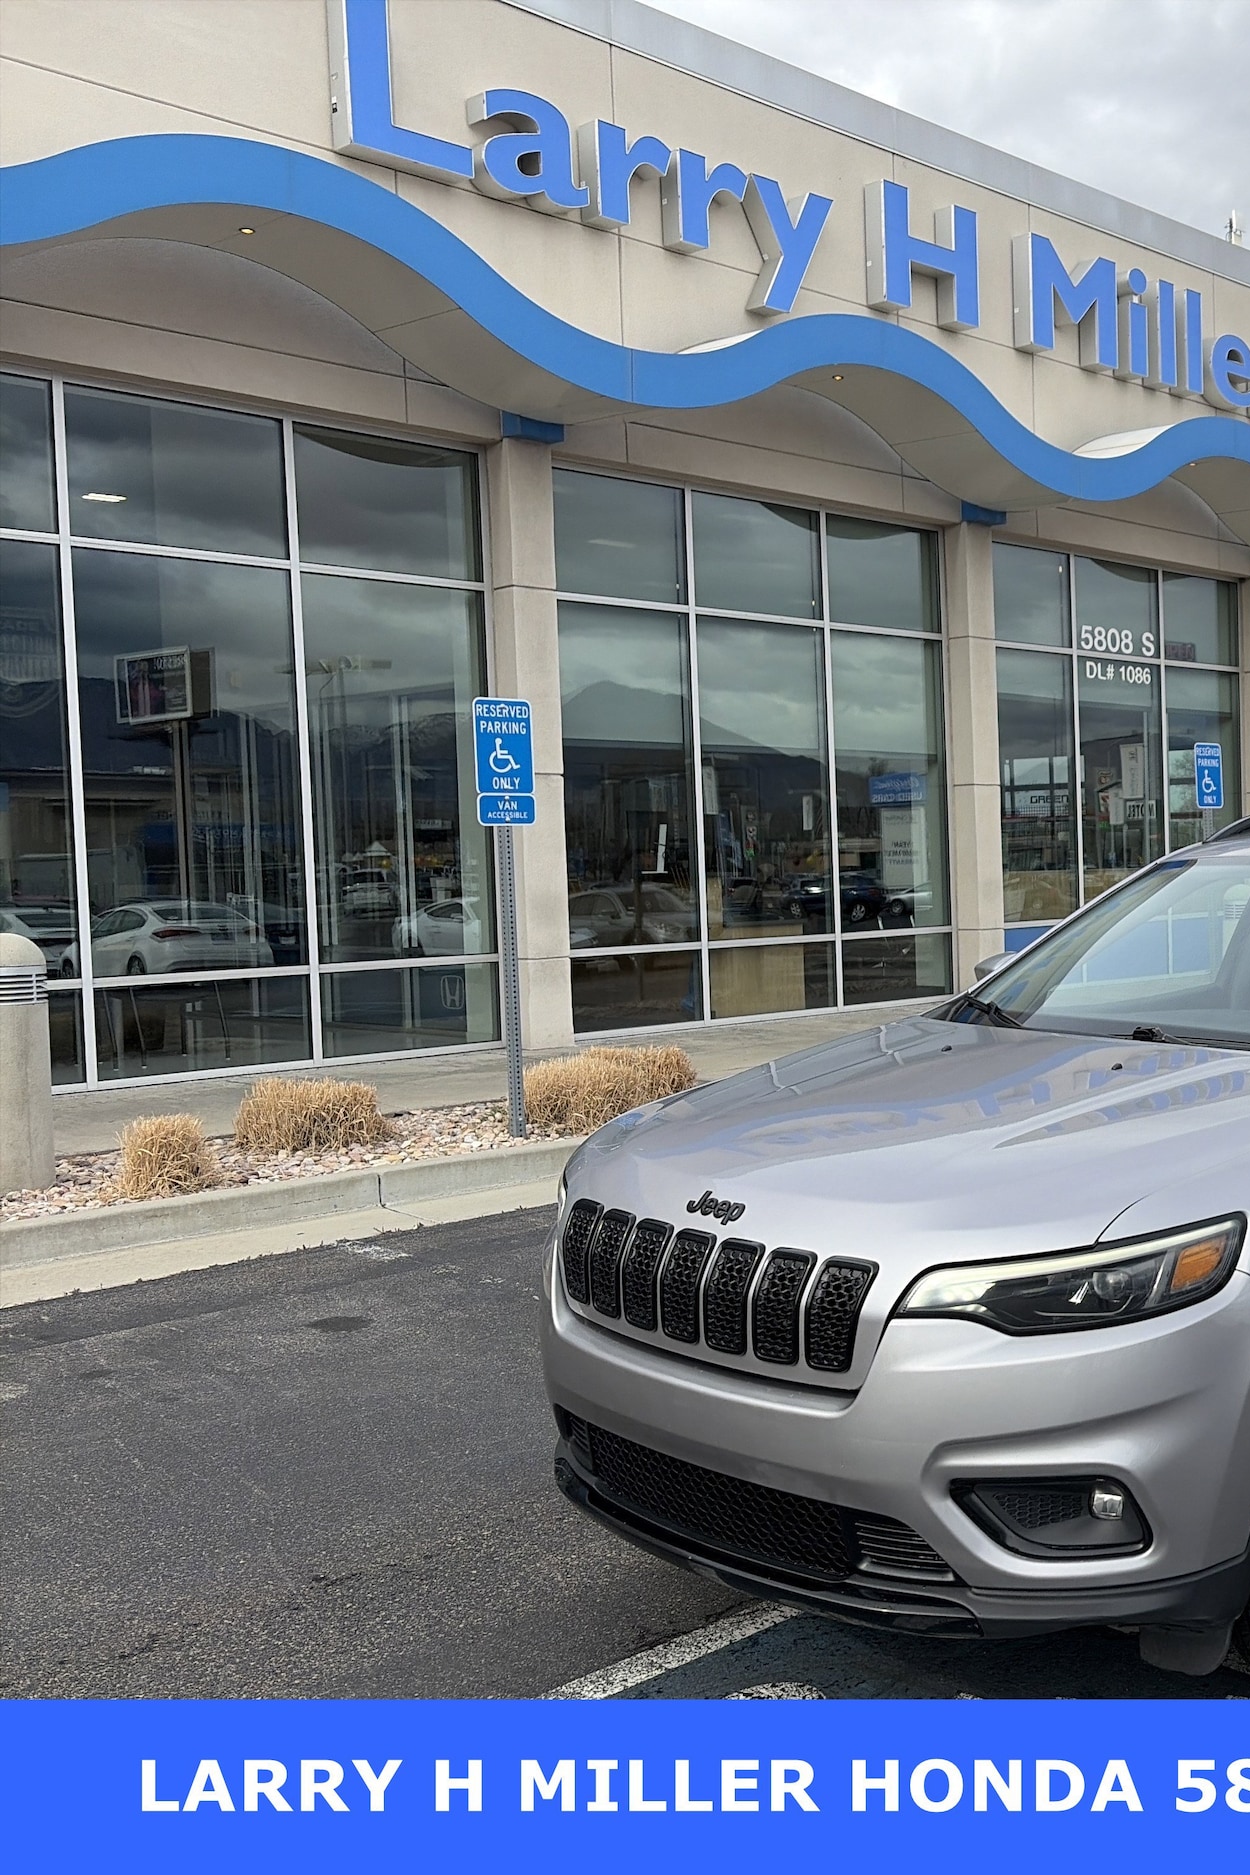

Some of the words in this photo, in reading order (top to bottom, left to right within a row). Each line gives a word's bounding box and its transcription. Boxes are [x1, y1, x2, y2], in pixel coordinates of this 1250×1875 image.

[336, 0, 834, 314] Larry
[866, 179, 979, 330] H
[1080, 625, 1134, 655] 5808
[1142, 631, 1155, 657] S
[1086, 660, 1115, 681] DL#
[1119, 665, 1151, 685] 1086
[476, 703, 529, 719] RESERVED
[480, 720, 527, 735] PARKING
[1196, 746, 1220, 757] RESERVED
[1197, 757, 1220, 768] PARKING
[492, 776, 520, 790] ONLY
[497, 800, 518, 811] VAN
[1203, 795, 1217, 804] ONLY
[487, 811, 528, 821] ACCESSIBLE
[686, 1190, 746, 1226] Jeep
